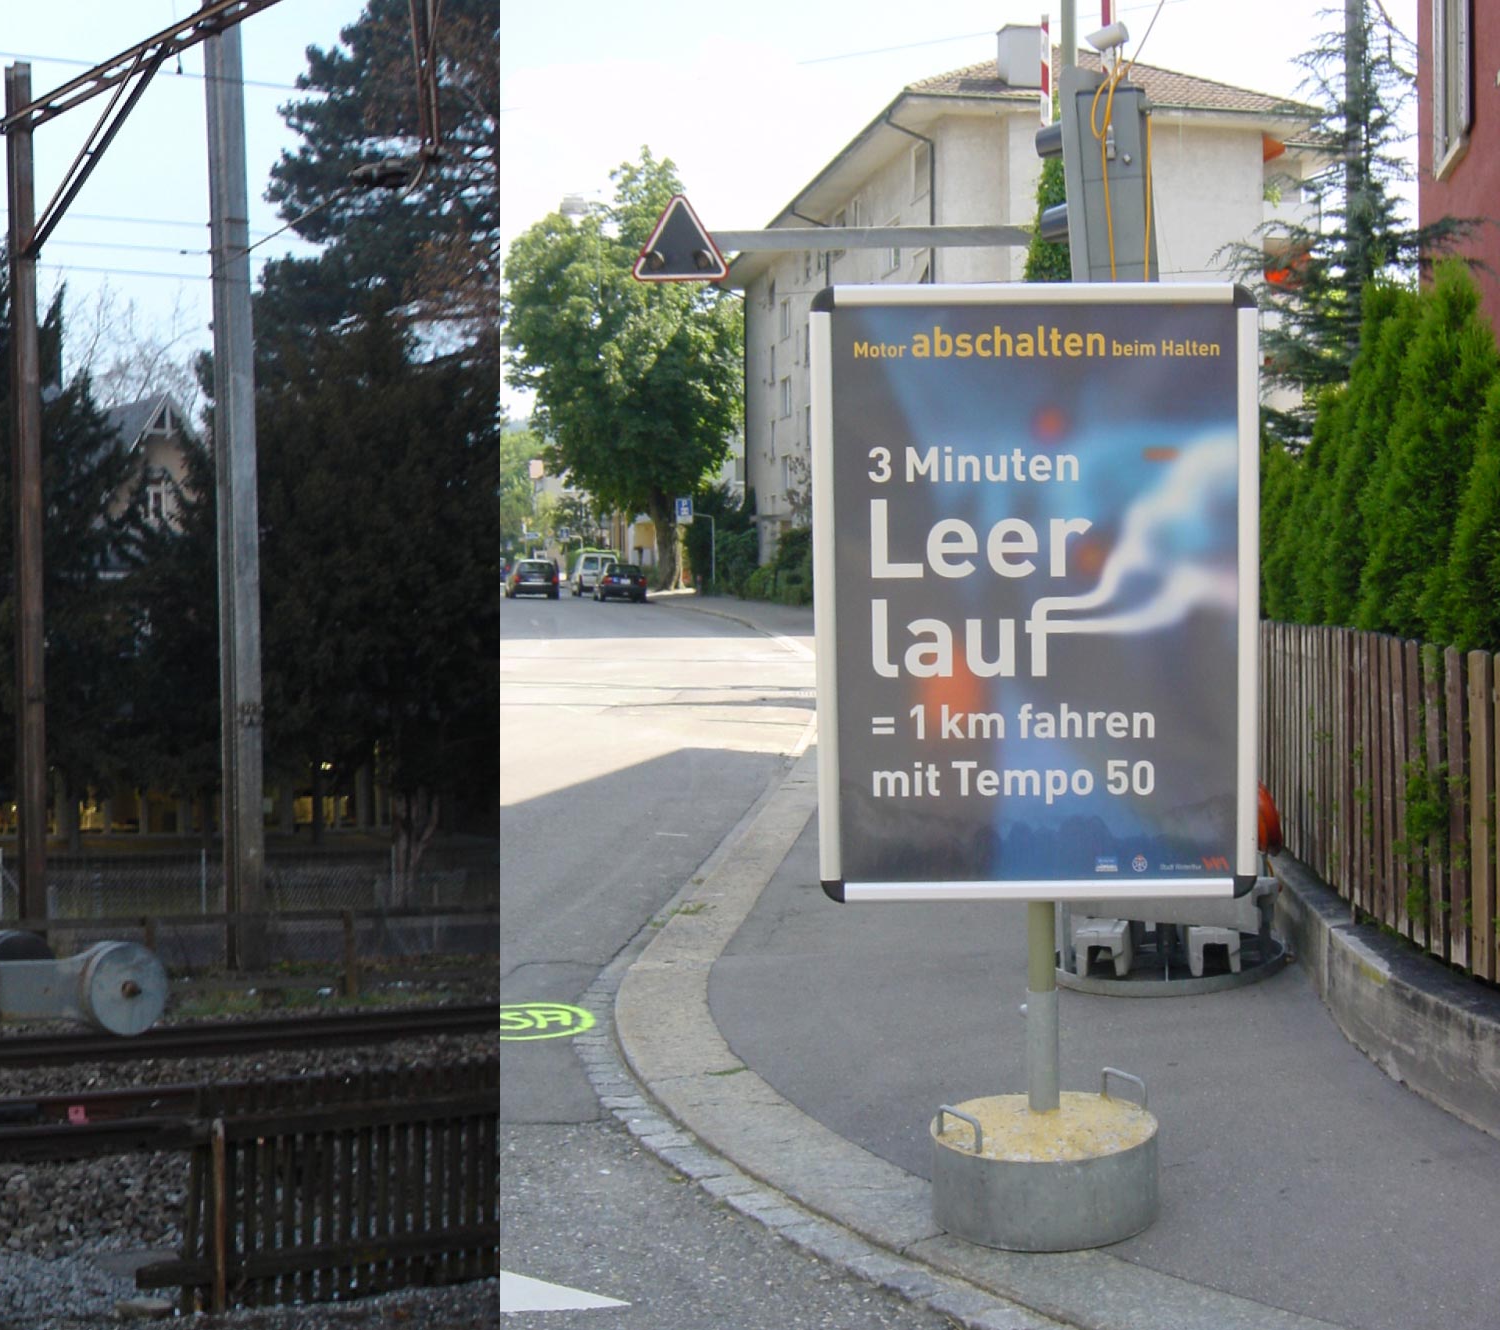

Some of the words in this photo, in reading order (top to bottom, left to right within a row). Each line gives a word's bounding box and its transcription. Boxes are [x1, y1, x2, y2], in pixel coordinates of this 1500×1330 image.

[854, 341, 907, 358] Motor
[912, 326, 1106, 358] abschalten
[1112, 340, 1156, 357] beim
[1161, 340, 1220, 357] Halten
[868, 447, 892, 483] 3
[906, 447, 1080, 483] Minuten
[870, 499, 1093, 579] Leer
[870, 596, 1072, 679] lauf
[909, 704, 925, 739] 1
[941, 704, 1005, 739] km
[1018, 703, 1156, 739] fahren
[872, 762, 940, 798] mit
[952, 760, 1094, 804] Tempo
[1106, 759, 1156, 797] 50
